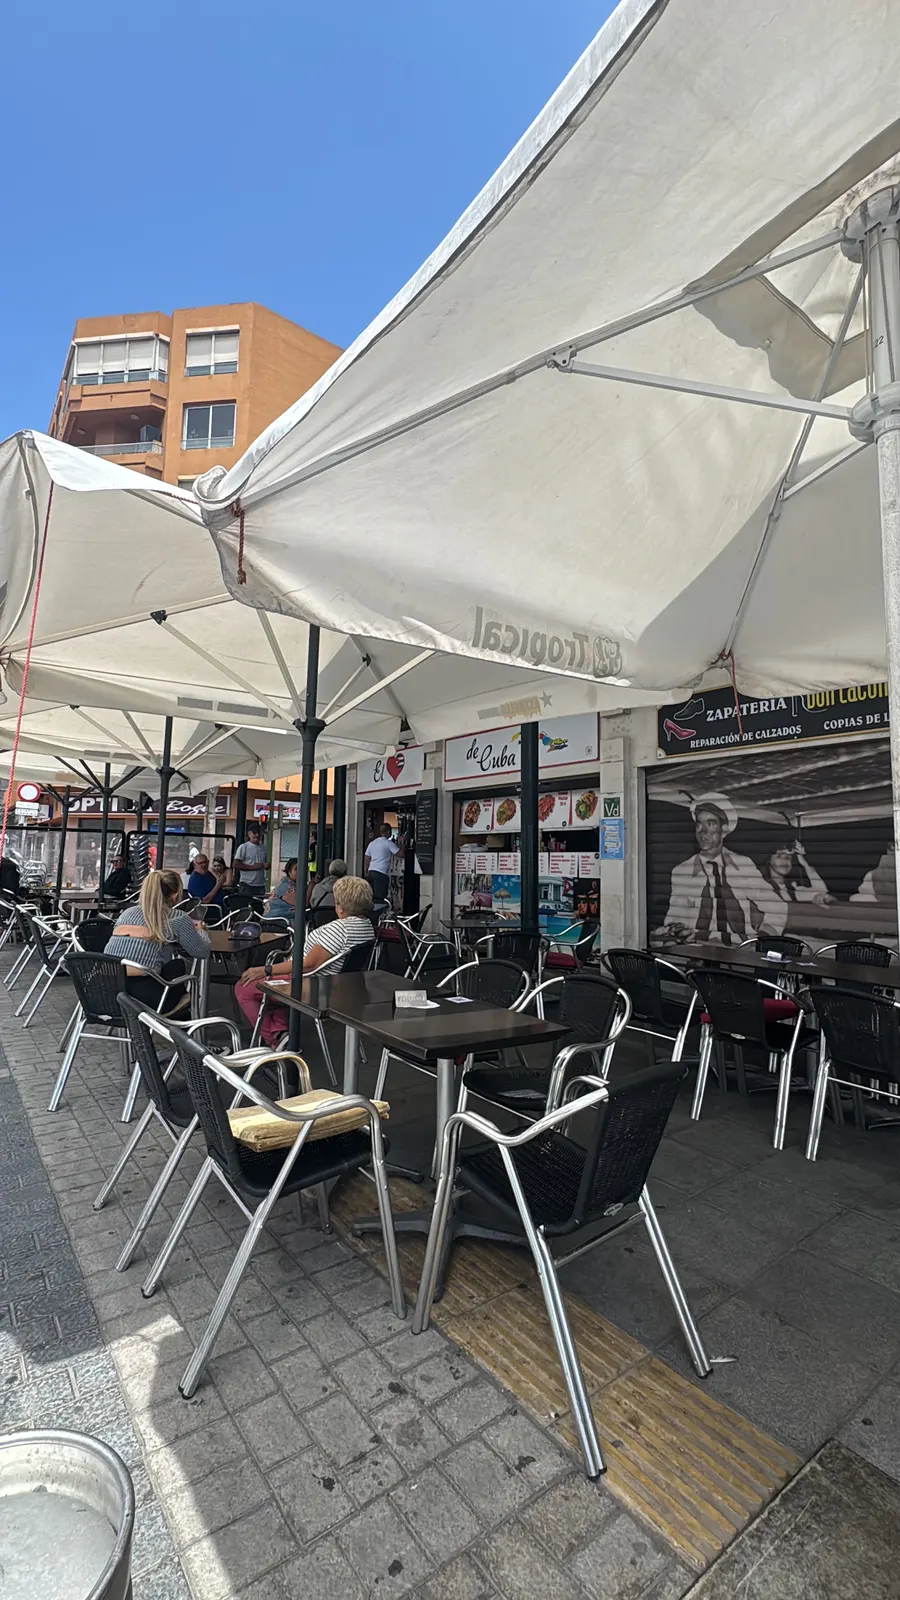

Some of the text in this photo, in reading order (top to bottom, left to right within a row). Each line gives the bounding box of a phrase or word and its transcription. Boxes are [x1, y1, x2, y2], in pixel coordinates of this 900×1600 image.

[706, 697, 787, 721] ZAPATERIA
[823, 716, 863, 730] COPIAS
[866, 713, 881, 725] DE
[690, 724, 802, 748] REPARACIÓN DE CALZADOS
[466, 738, 516, 772] de Cuba
[373, 759, 384, 783] El
[604, 802, 619, 817] Vd
